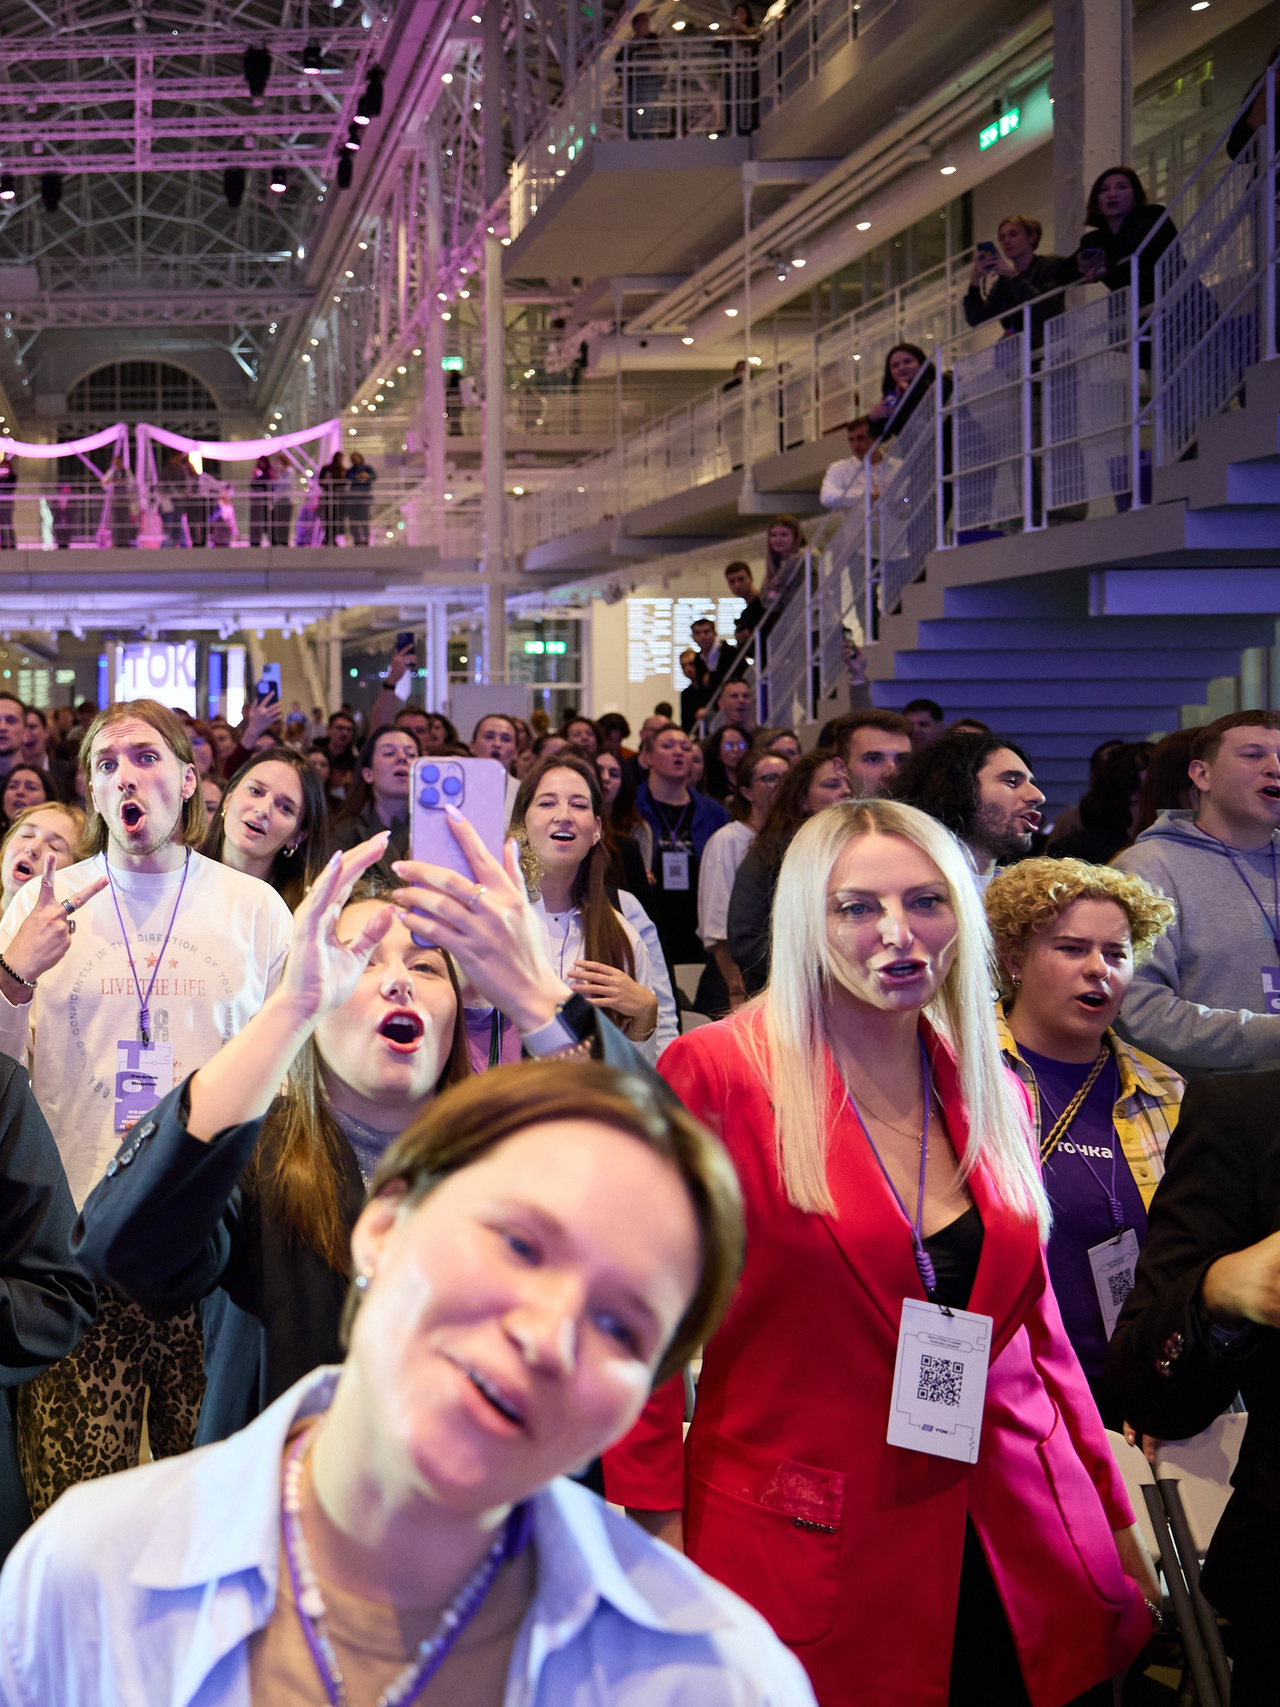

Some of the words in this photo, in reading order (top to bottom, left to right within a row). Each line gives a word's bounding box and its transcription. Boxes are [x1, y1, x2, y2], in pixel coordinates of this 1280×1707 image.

[69, 960, 95, 1036] CONFIDENTLY
[96, 948, 108, 960] IN
[100, 978, 135, 995] LIVE
[139, 978, 169, 996] THE
[174, 979, 207, 997] LIFE
[1057, 1141, 1114, 1159] точка
